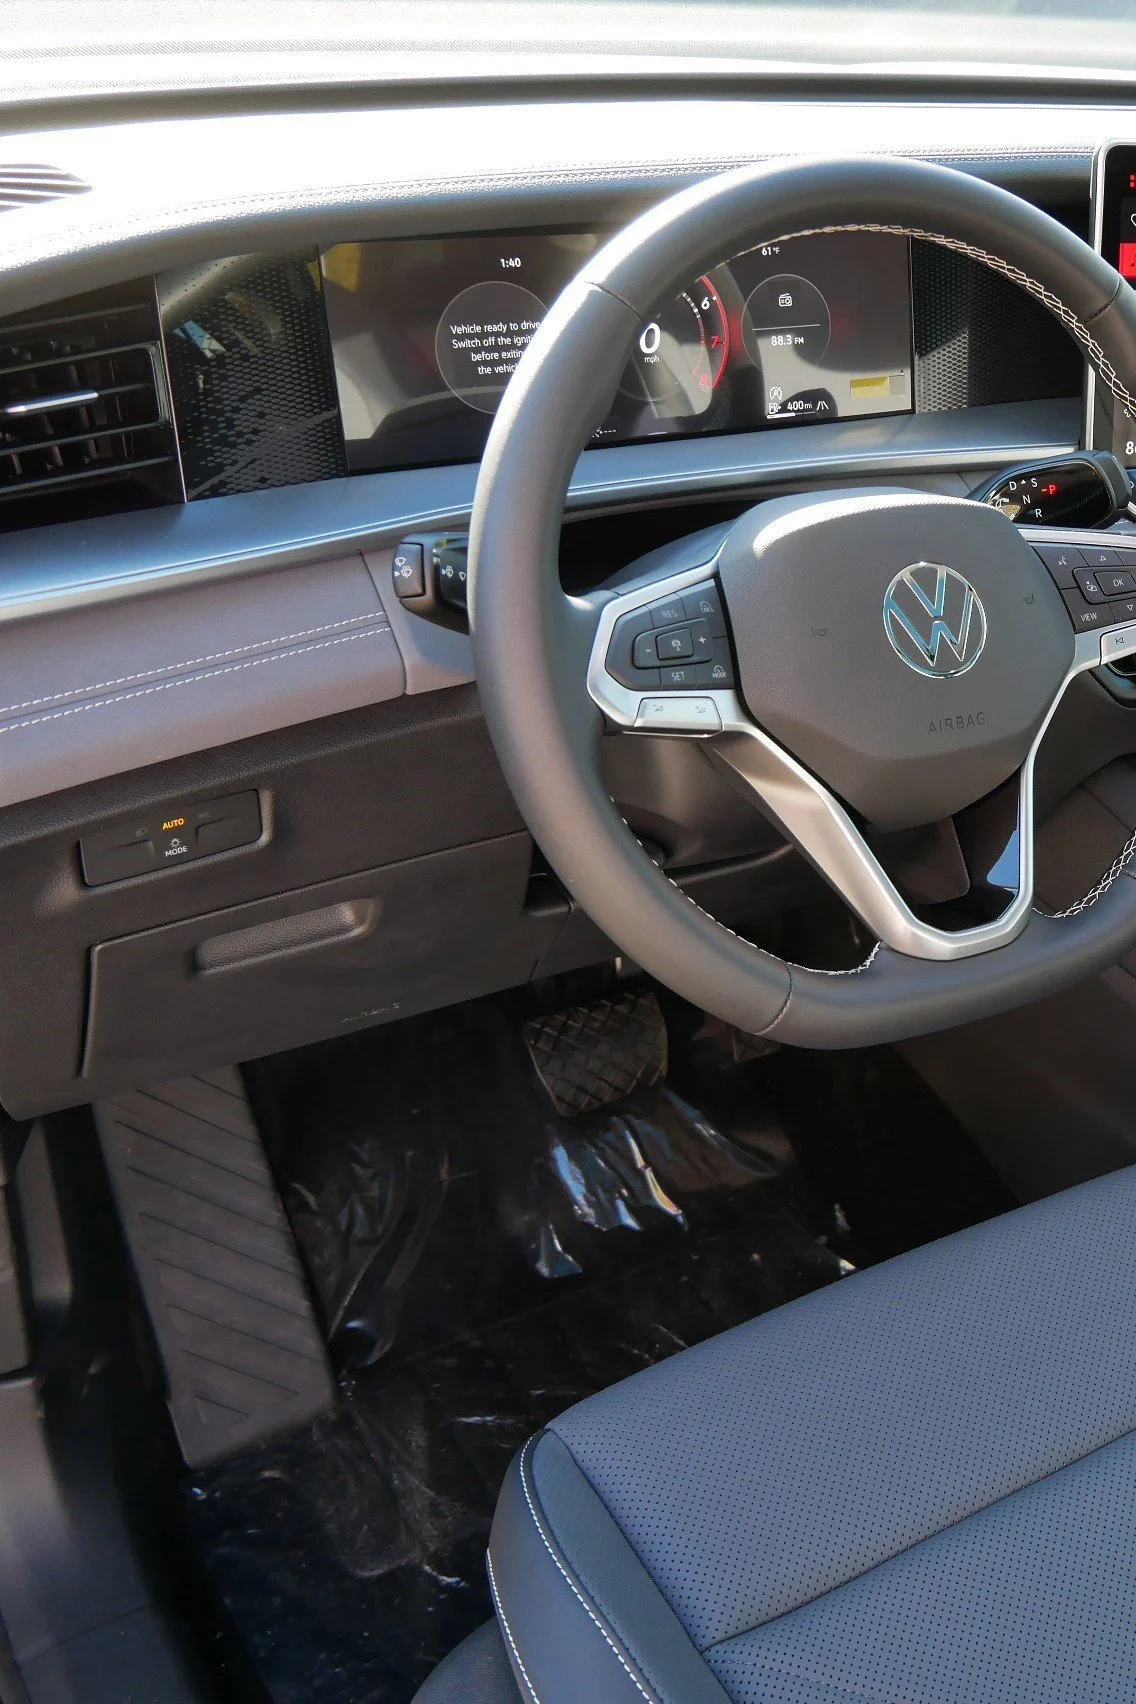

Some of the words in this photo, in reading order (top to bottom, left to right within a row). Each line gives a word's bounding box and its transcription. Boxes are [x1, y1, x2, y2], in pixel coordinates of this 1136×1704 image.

[500, 257, 521, 268] 1:40
[701, 296, 710, 310] 6
[450, 324, 482, 334] Vehicle
[484, 321, 507, 334] ready
[510, 322, 519, 331] to
[521, 320, 540, 330] drive
[452, 338, 481, 349] Switch
[483, 336, 496, 347] off
[497, 336, 512, 345] the
[513, 335, 533, 346] ignit
[639, 322, 660, 354] 0
[711, 335, 720, 349] 7
[771, 335, 793, 347] 88.3
[794, 337, 805, 345] FM
[471, 351, 500, 362] before
[501, 349, 524, 359] exitin
[644, 355, 660, 364] mph
[478, 365, 492, 375] the
[1009, 481, 1017, 491] D
[1030, 478, 1038, 488] S
[1049, 485, 1056, 495] P
[1022, 494, 1031, 504] N
[1035, 509, 1043, 518] R
[1113, 578, 1124, 587] OK
[661, 609, 678, 618] RES
[1080, 612, 1098, 621] VIEW
[671, 671, 685, 681] SET
[712, 671, 727, 679] MODE
[928, 712, 986, 735] AIRBAG
[162, 818, 185, 830] AUTO
[165, 845, 188, 857] MODE
